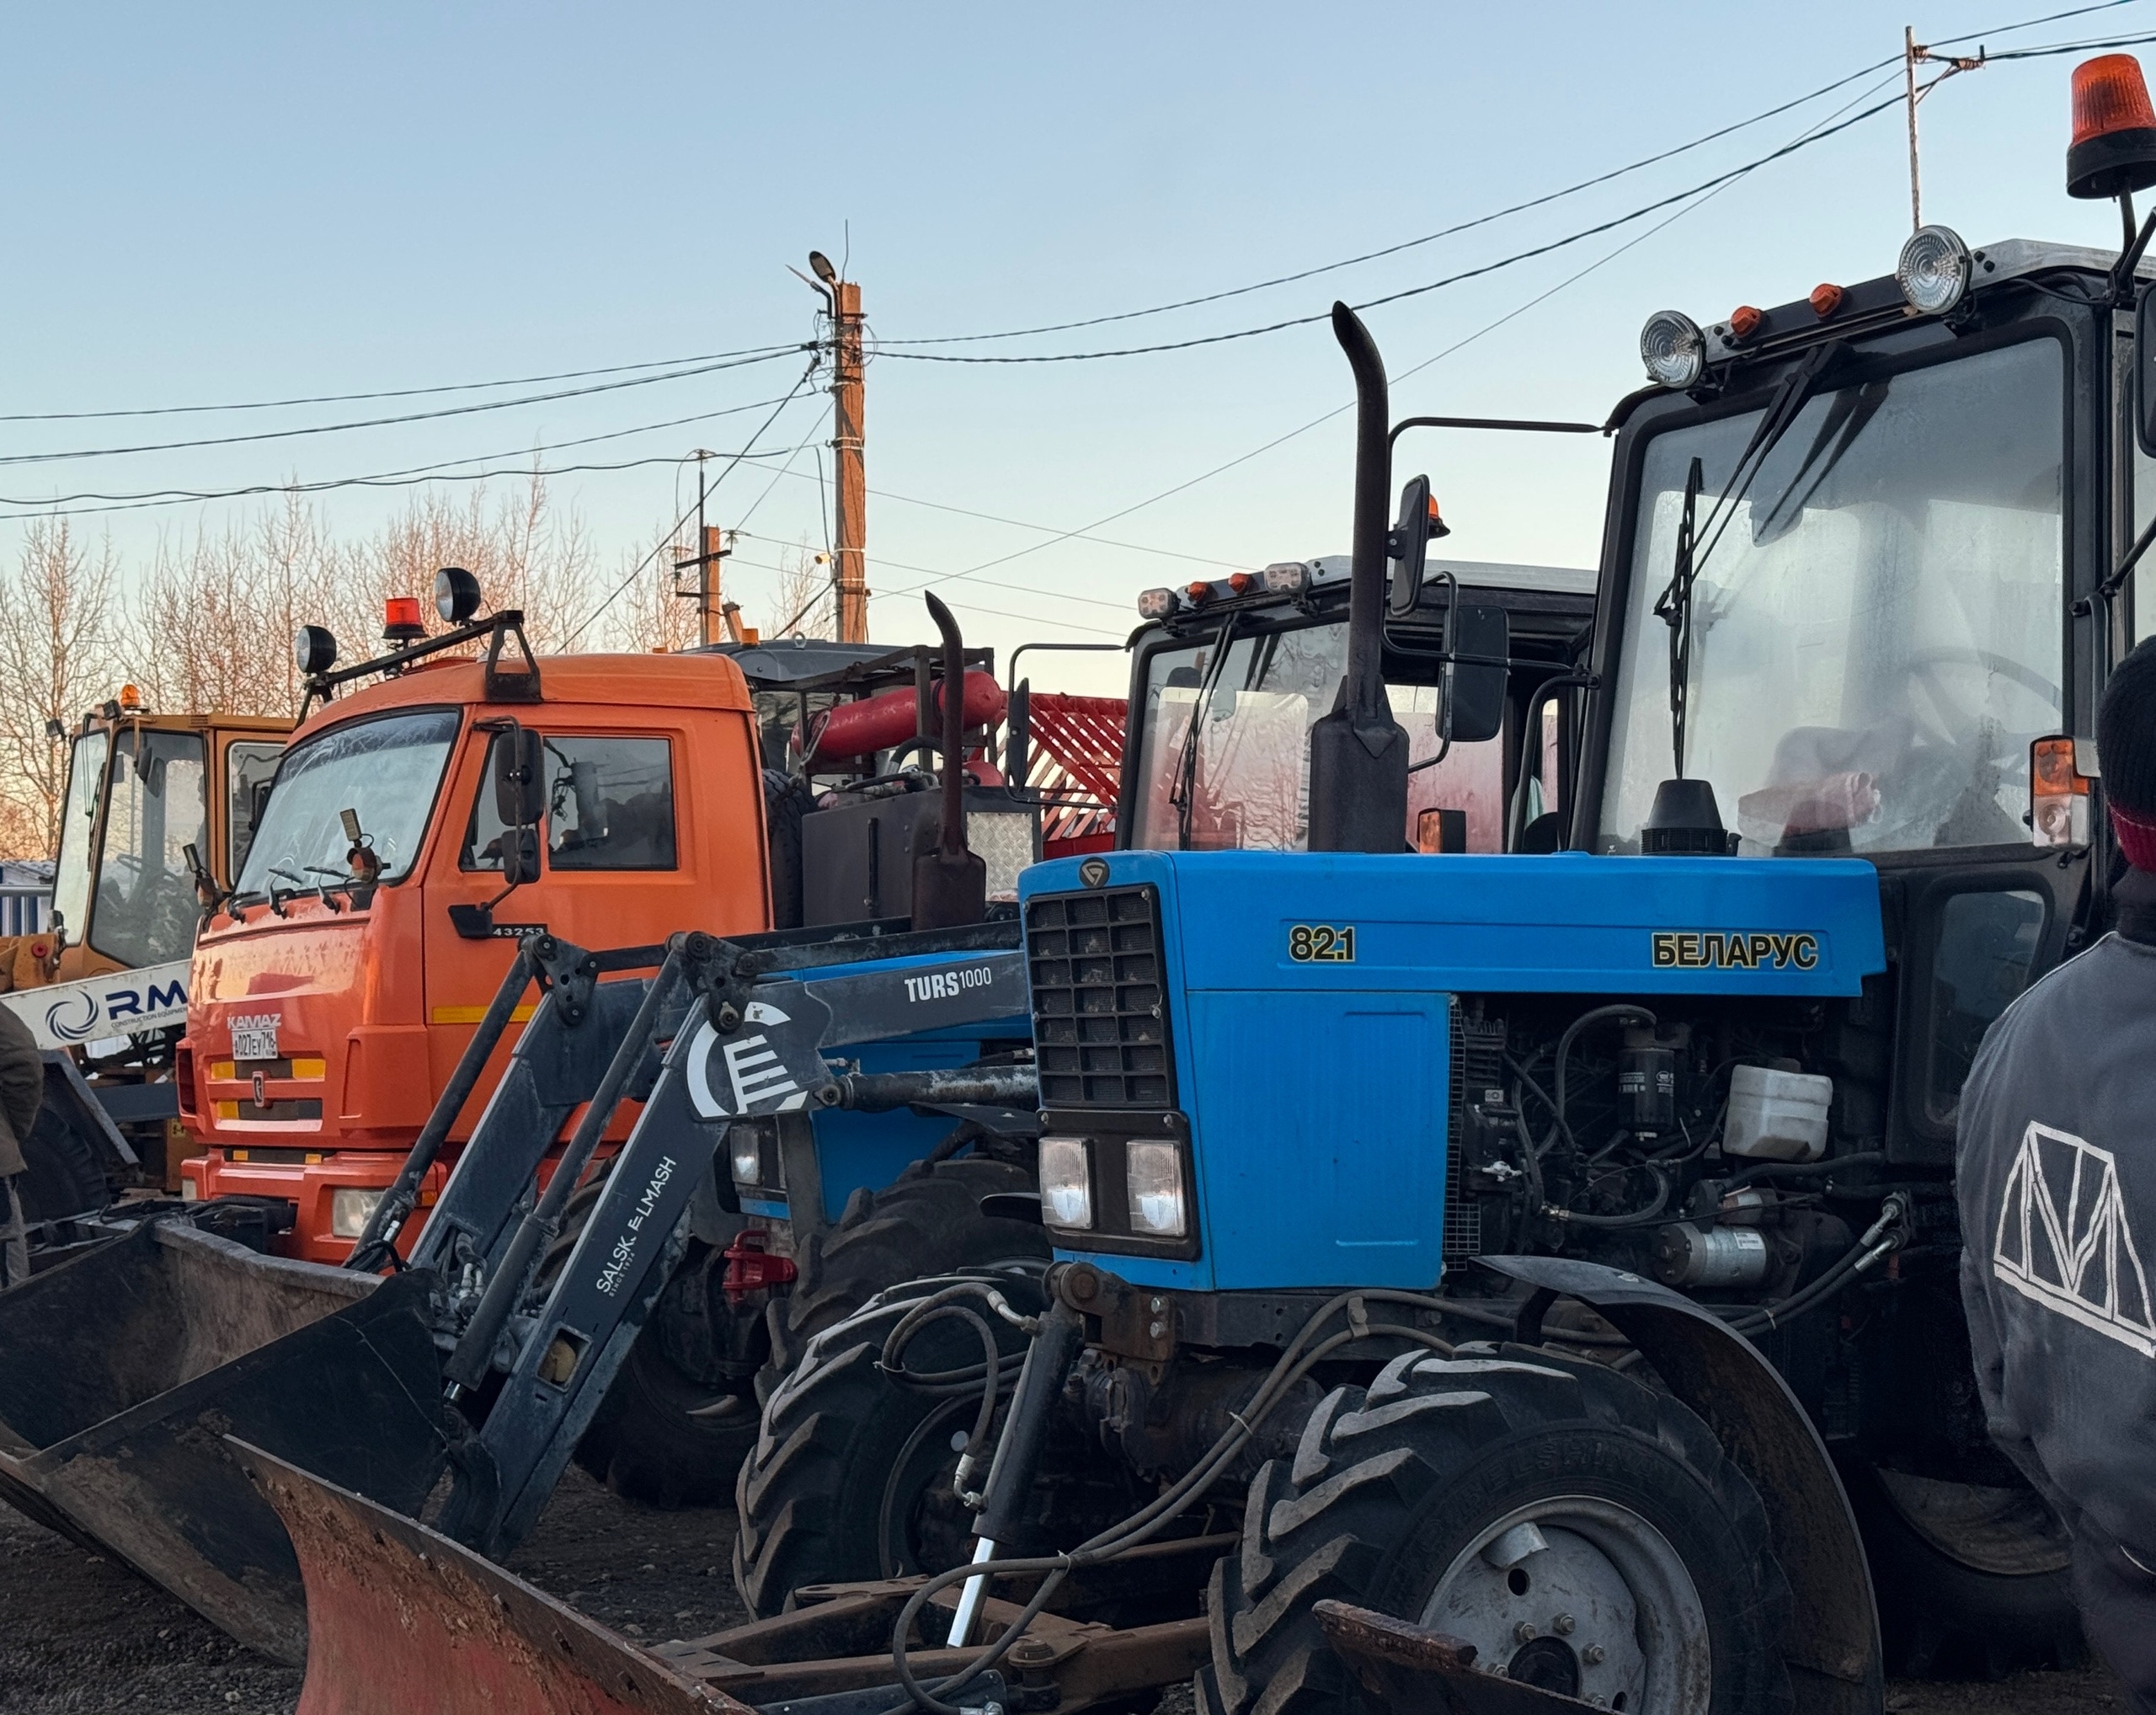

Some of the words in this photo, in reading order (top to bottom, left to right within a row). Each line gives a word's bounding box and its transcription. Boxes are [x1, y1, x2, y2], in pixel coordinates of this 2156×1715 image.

[1289, 925, 1355, 962] 82.1
[1652, 932, 1817, 970] БЕЛАРУС
[111, 1013, 157, 1028] CONSTRUCTION
[227, 1013, 282, 1029] KAMAZ
[608, 1272, 626, 1297] SINCE
